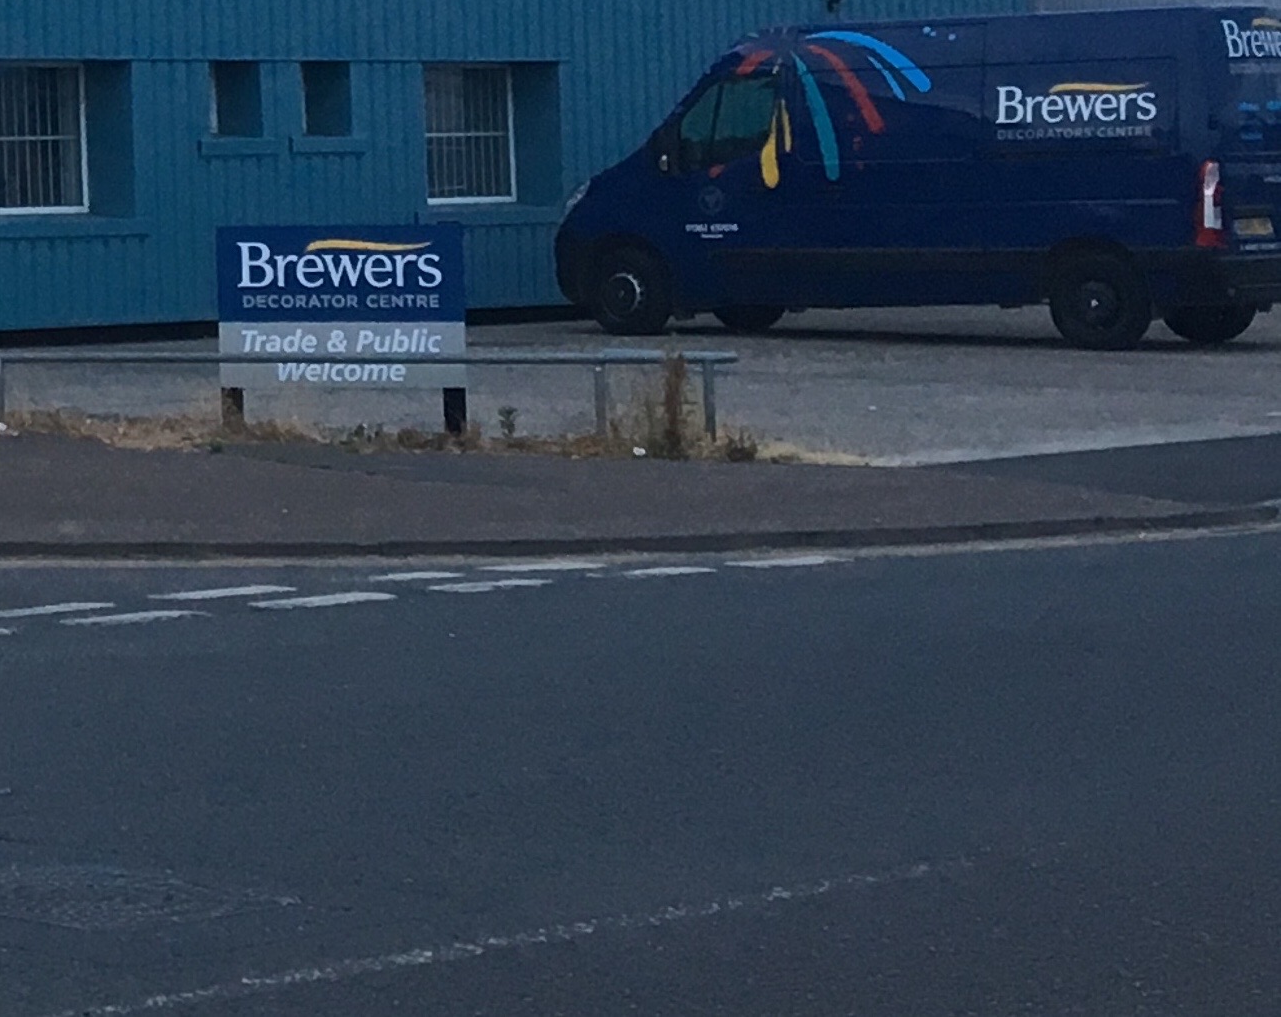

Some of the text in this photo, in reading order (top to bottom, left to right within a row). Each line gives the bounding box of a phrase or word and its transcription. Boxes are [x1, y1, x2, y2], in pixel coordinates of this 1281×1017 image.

[995, 85, 1157, 124] Brewers
[236, 242, 442, 288] Brewers
[242, 294, 440, 308] DECORATOR CENTRE
[241, 328, 441, 353] Trade & Public
